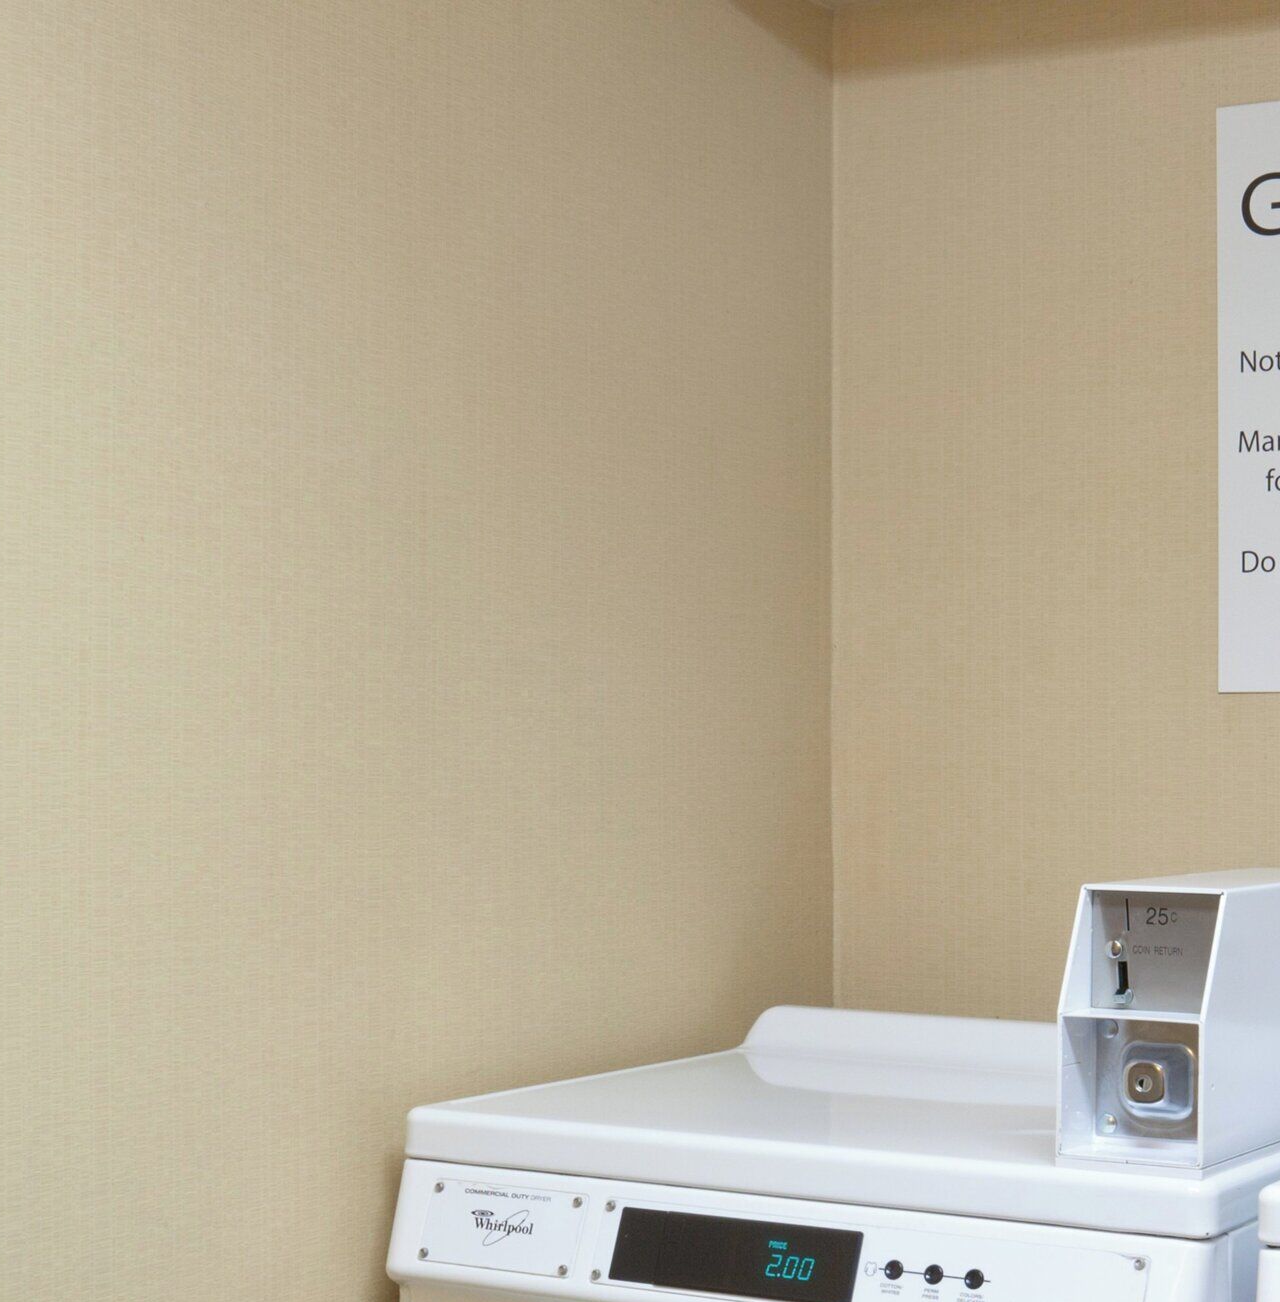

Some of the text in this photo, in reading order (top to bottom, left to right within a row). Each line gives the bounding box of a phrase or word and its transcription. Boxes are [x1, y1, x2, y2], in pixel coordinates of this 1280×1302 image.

[1241, 550, 1276, 574] Do
[1153, 946, 1183, 956] RETURN
[464, 1187, 510, 1198] COMMERCIAL
[511, 1192, 529, 1200] DUTY
[474, 1216, 534, 1236] Whirlpool
[765, 1253, 816, 1281] 2.00
